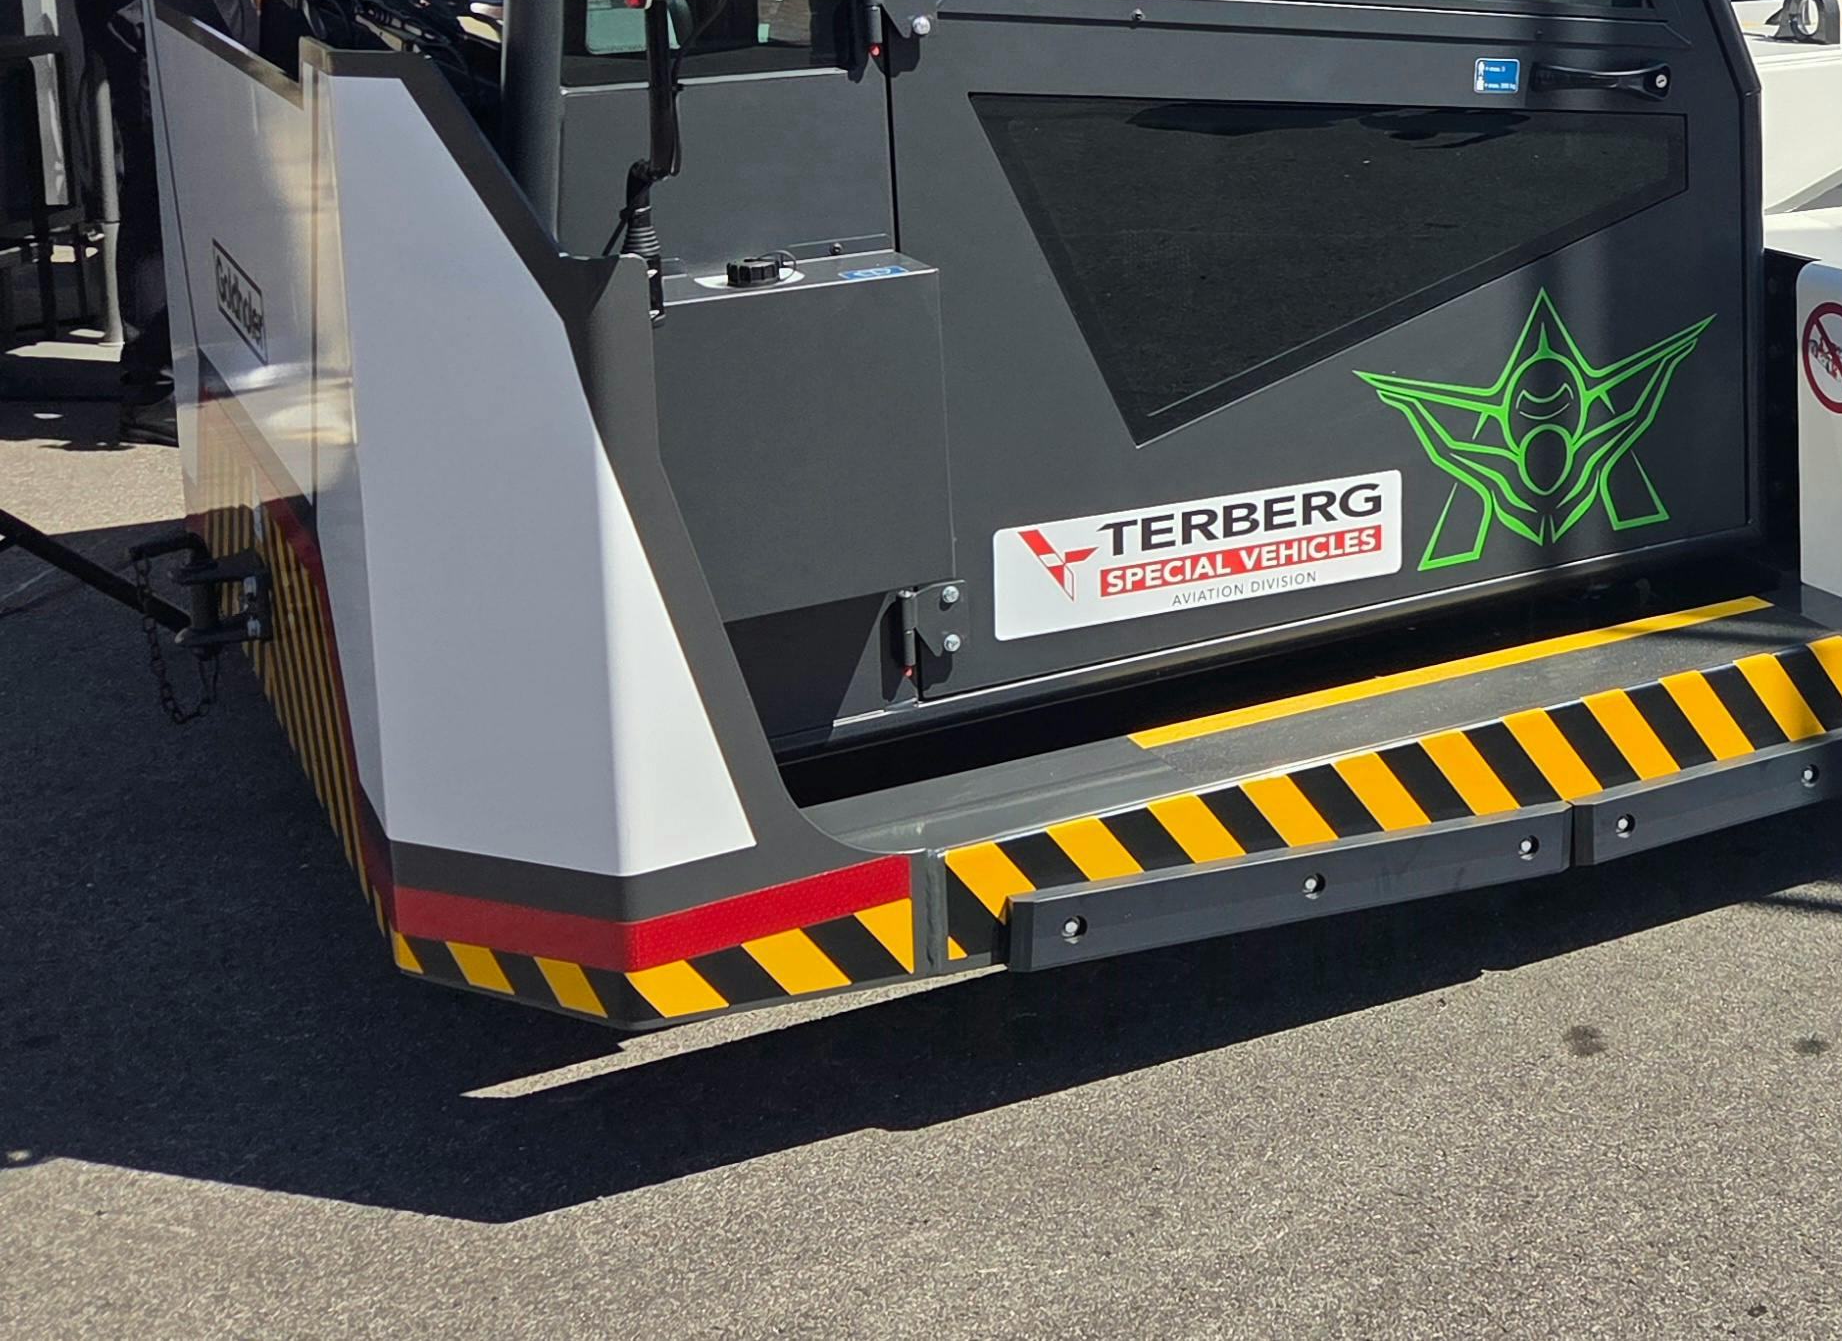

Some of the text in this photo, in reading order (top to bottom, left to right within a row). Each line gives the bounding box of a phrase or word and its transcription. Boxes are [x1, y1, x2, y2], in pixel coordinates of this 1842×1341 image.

[1096, 483, 1382, 557] TERBERG
[1105, 527, 1378, 593] SPECIAL VEHICLES
[1172, 570, 1317, 607] AVIATION DIVISION
